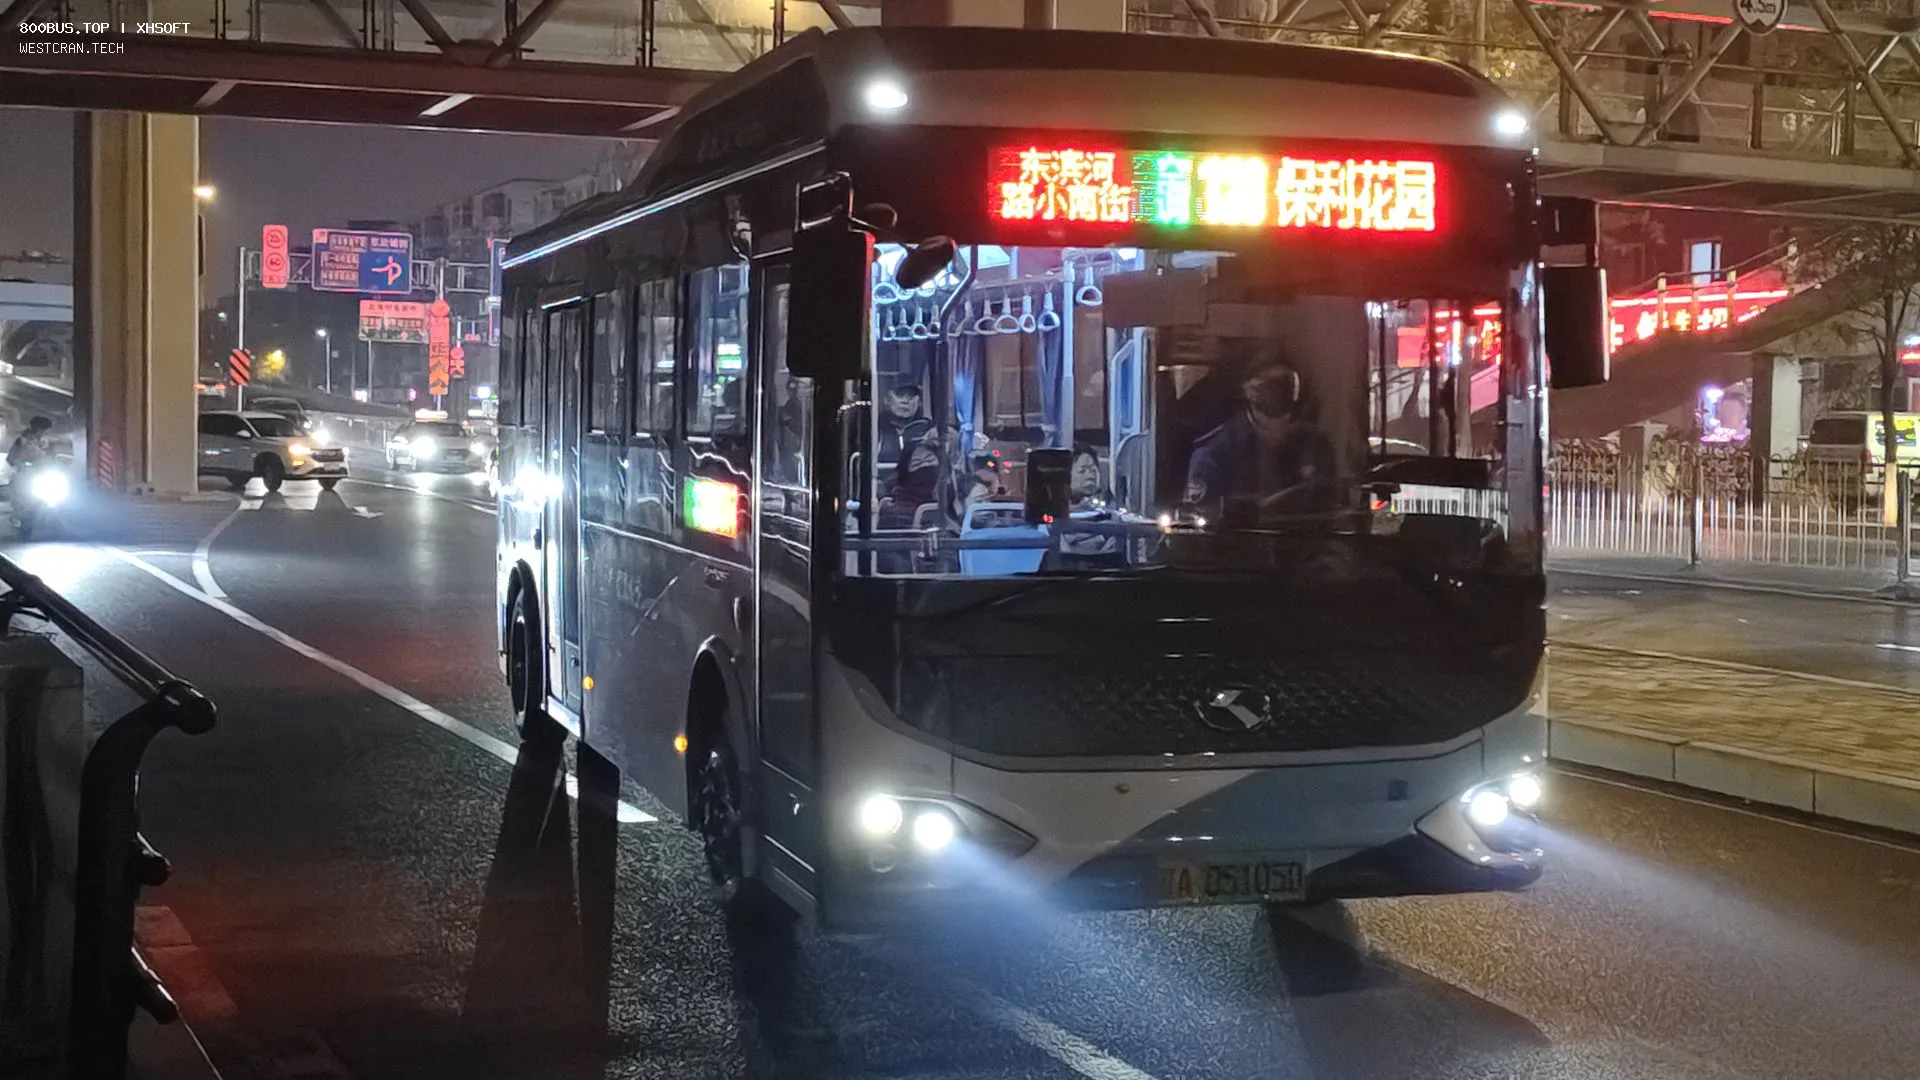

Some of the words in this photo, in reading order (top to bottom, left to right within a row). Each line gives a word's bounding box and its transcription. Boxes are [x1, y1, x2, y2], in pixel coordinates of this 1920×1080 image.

[1019, 147, 1116, 185] 东滨河
[1001, 181, 1132, 222] 路小南街
[1274, 156, 1436, 231] 保利花园
